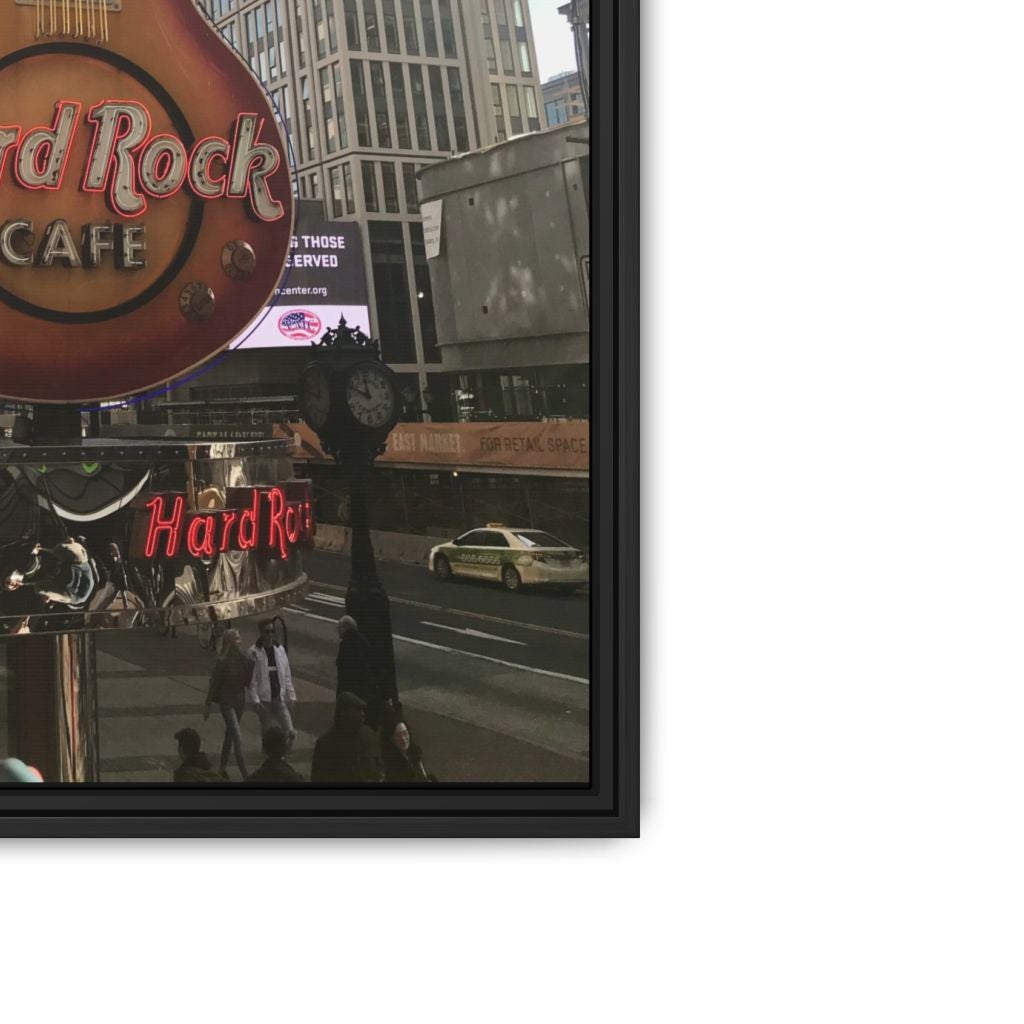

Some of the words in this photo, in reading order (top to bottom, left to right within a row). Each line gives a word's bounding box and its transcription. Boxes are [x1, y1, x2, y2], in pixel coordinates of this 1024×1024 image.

[82, 99, 284, 222] Rock
[301, 235, 345, 249] THOSE
[392, 432, 416, 451] EAST
[480, 437, 502, 452] FOR
[505, 437, 544, 453] RETAIL
[547, 437, 587, 454] SPACE
[144, 488, 261, 558] Hard
